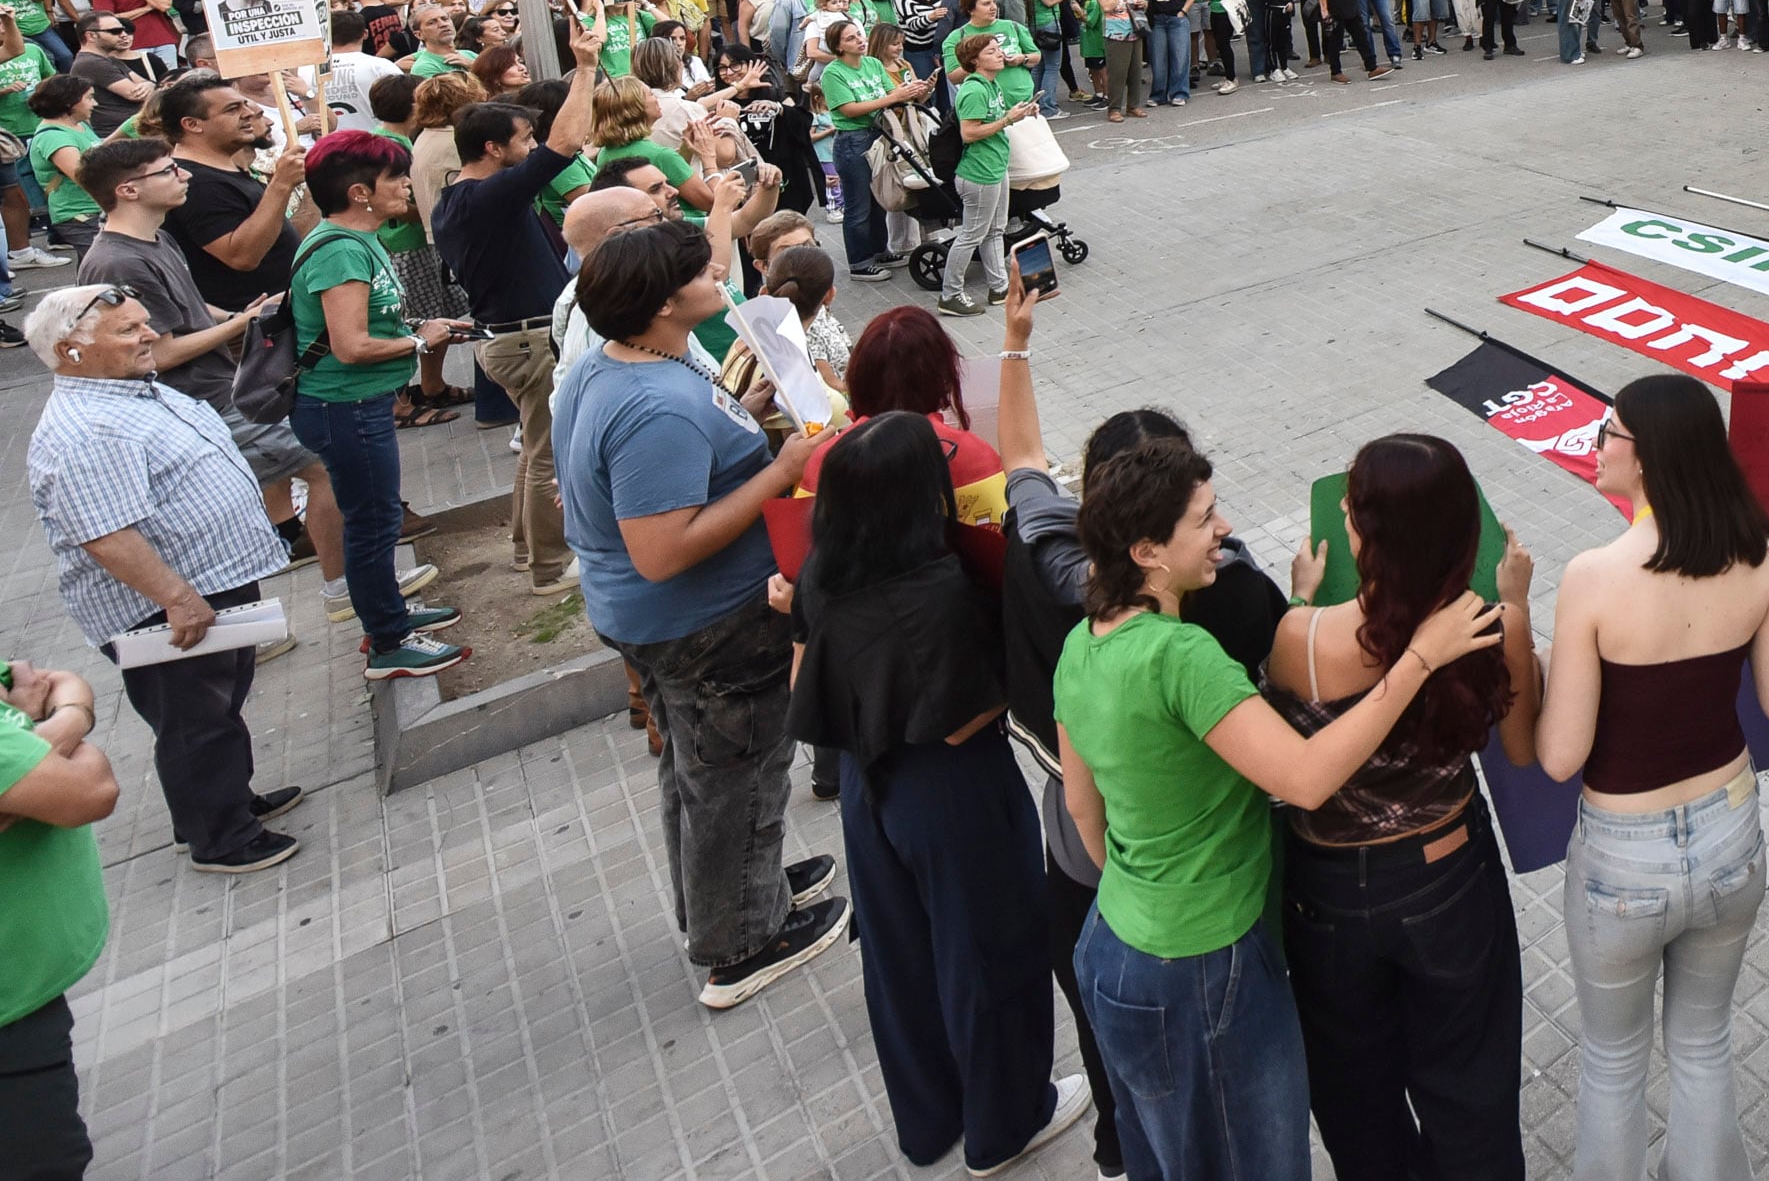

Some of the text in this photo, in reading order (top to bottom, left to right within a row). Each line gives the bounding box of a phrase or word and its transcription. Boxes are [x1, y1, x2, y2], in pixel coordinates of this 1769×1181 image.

[228, 6, 266, 21] POR UNA
[228, 12, 301, 35] INSPECCIÓN
[261, 31, 268, 41] Y
[269, 26, 296, 40] JUSTA
[1482, 381, 1558, 417] CGT
[1501, 400, 1546, 419] Rioja
[1513, 398, 1574, 424] Aragón
